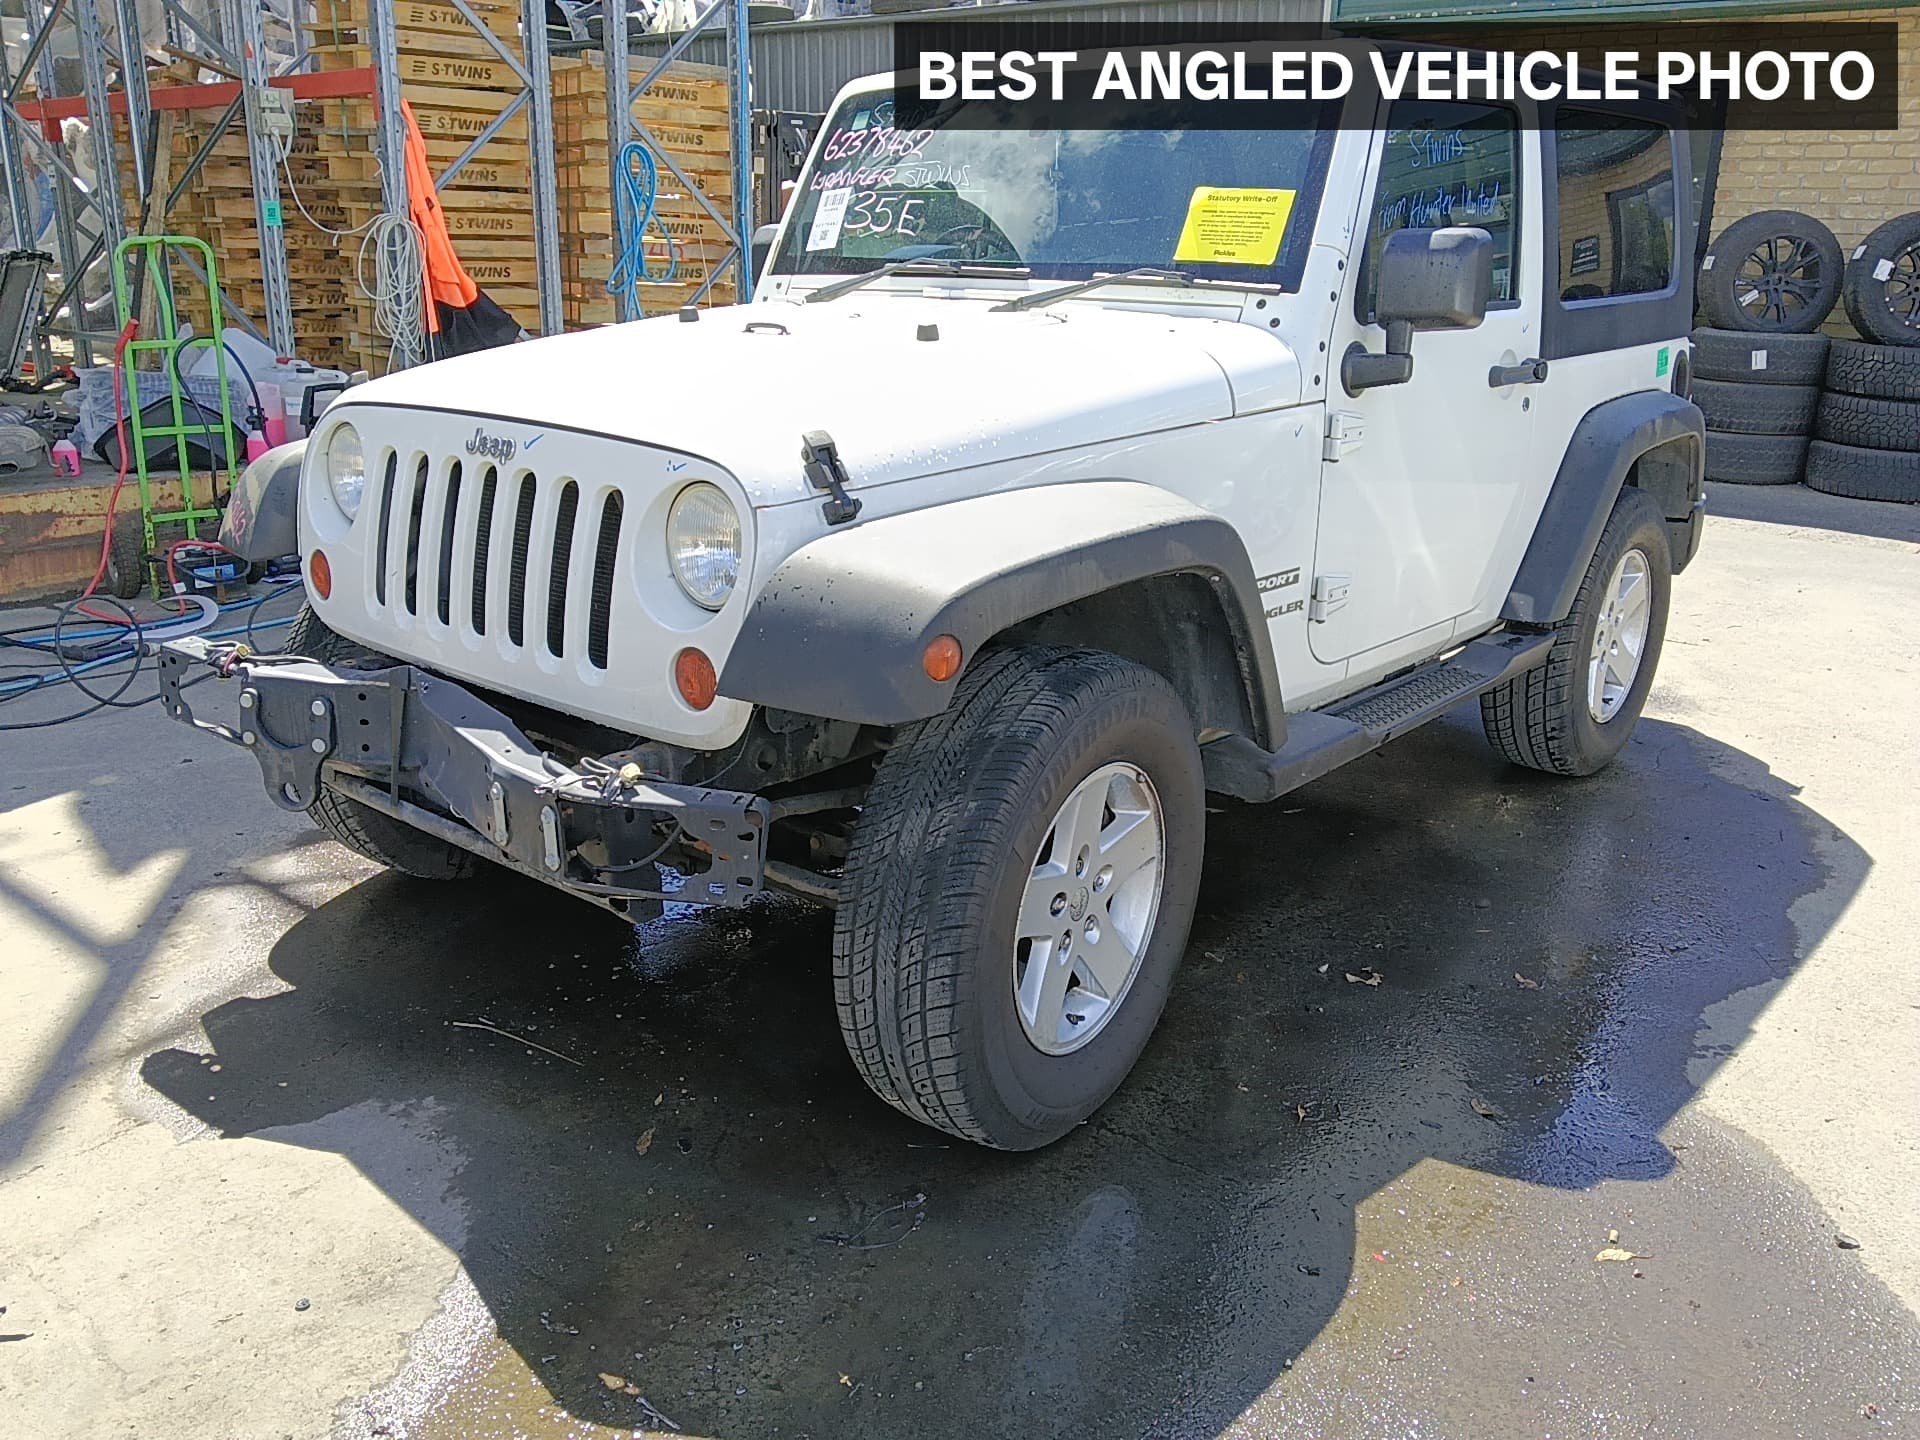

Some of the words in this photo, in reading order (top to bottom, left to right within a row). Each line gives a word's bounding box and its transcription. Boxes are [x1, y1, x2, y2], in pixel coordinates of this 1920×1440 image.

[823, 126, 936, 161] 62378462
[1207, 194, 1241, 203] Statutory
[1243, 195, 1278, 203] Write-Off
[844, 190, 925, 236] 35E
[466, 428, 516, 465] Jeep
[1256, 570, 1300, 589] PORT
[1265, 599, 1304, 618] GLER
